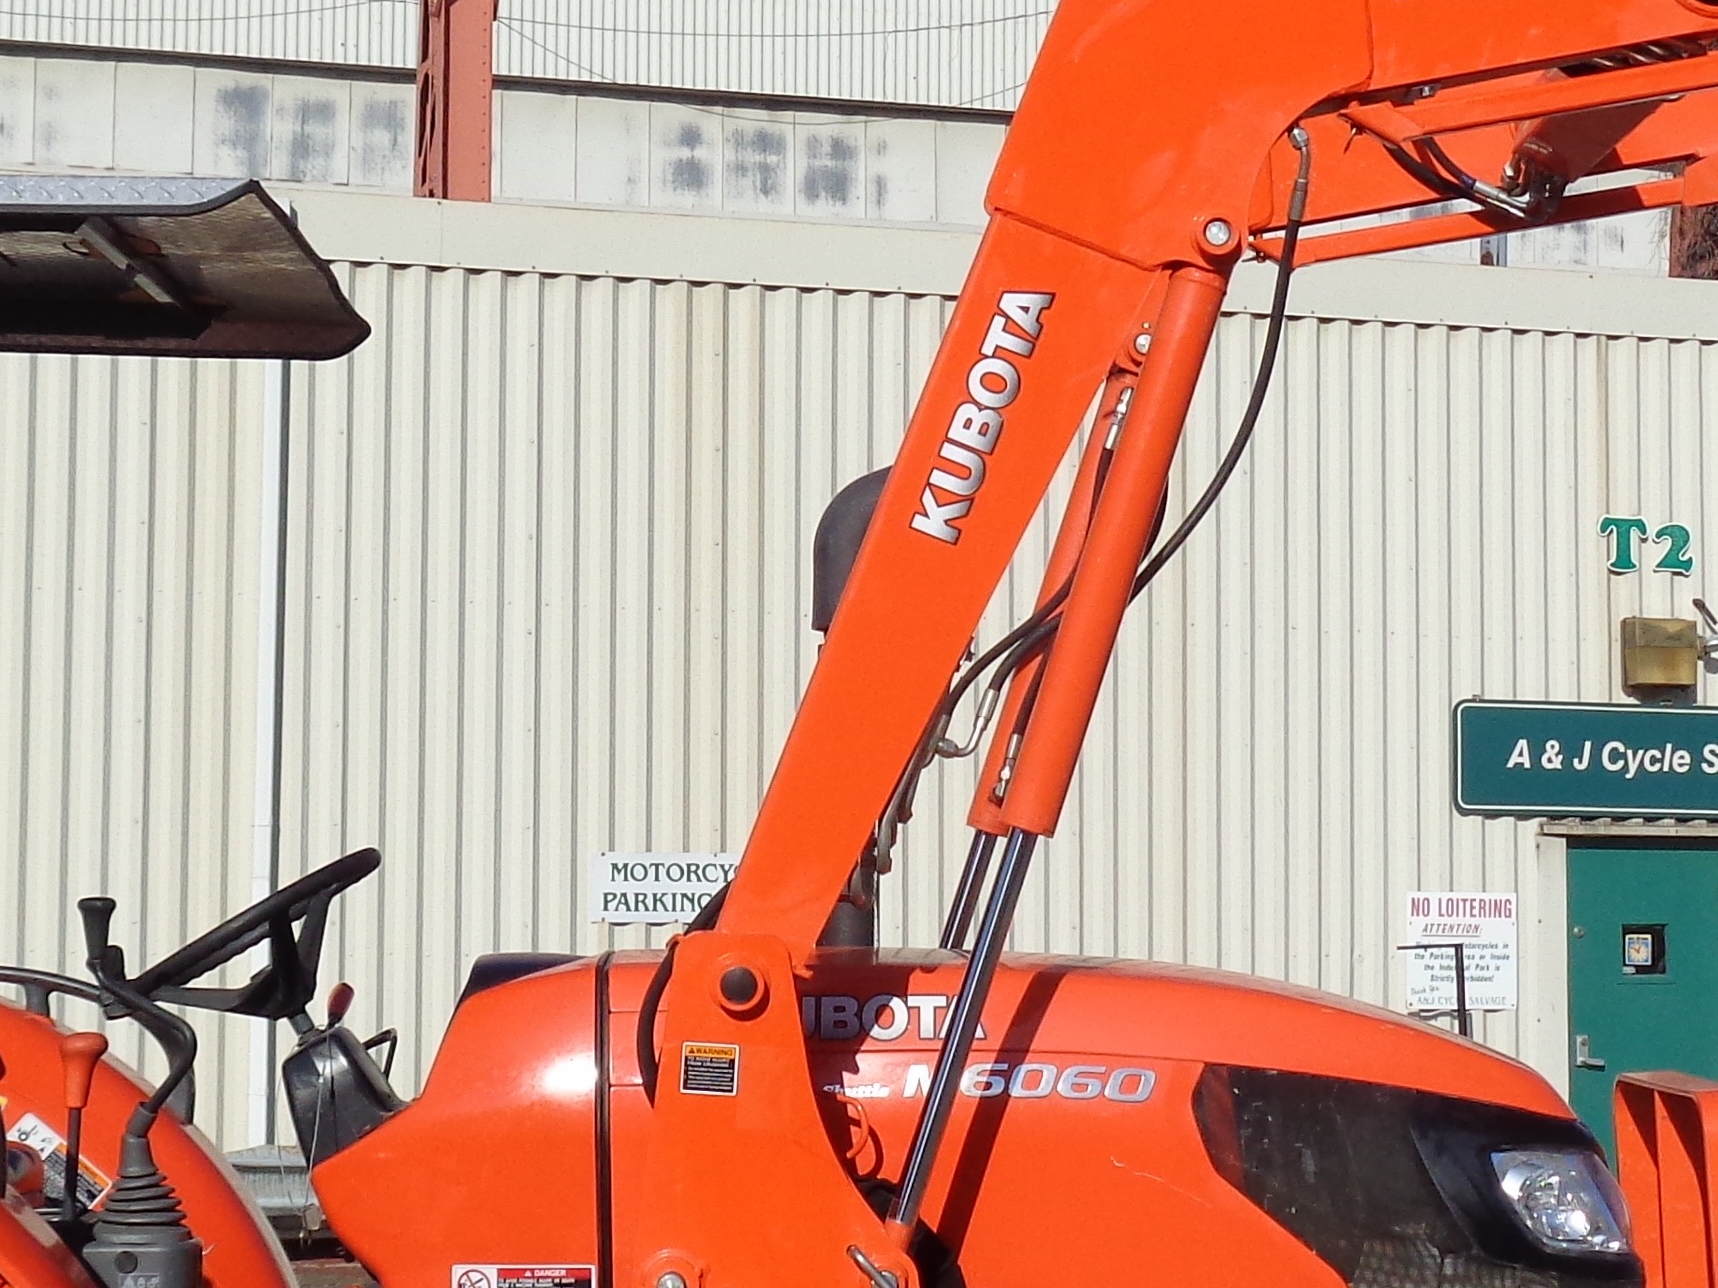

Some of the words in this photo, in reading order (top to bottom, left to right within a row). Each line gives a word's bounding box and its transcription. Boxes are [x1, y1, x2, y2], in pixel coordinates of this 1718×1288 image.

[909, 291, 1056, 545] KUBOTA
[1598, 515, 1694, 576] T2
[1506, 738, 1531, 769] A
[1540, 740, 1564, 770] &
[1572, 741, 1592, 771] J
[1601, 742, 1691, 779] Cycle
[610, 862, 738, 883] MOTORCY
[1411, 897, 1431, 918] NO
[1438, 897, 1512, 919] LOITERING
[1464, 942, 1498, 950] otorcycles
[534, 1269, 567, 1277] DANGER
